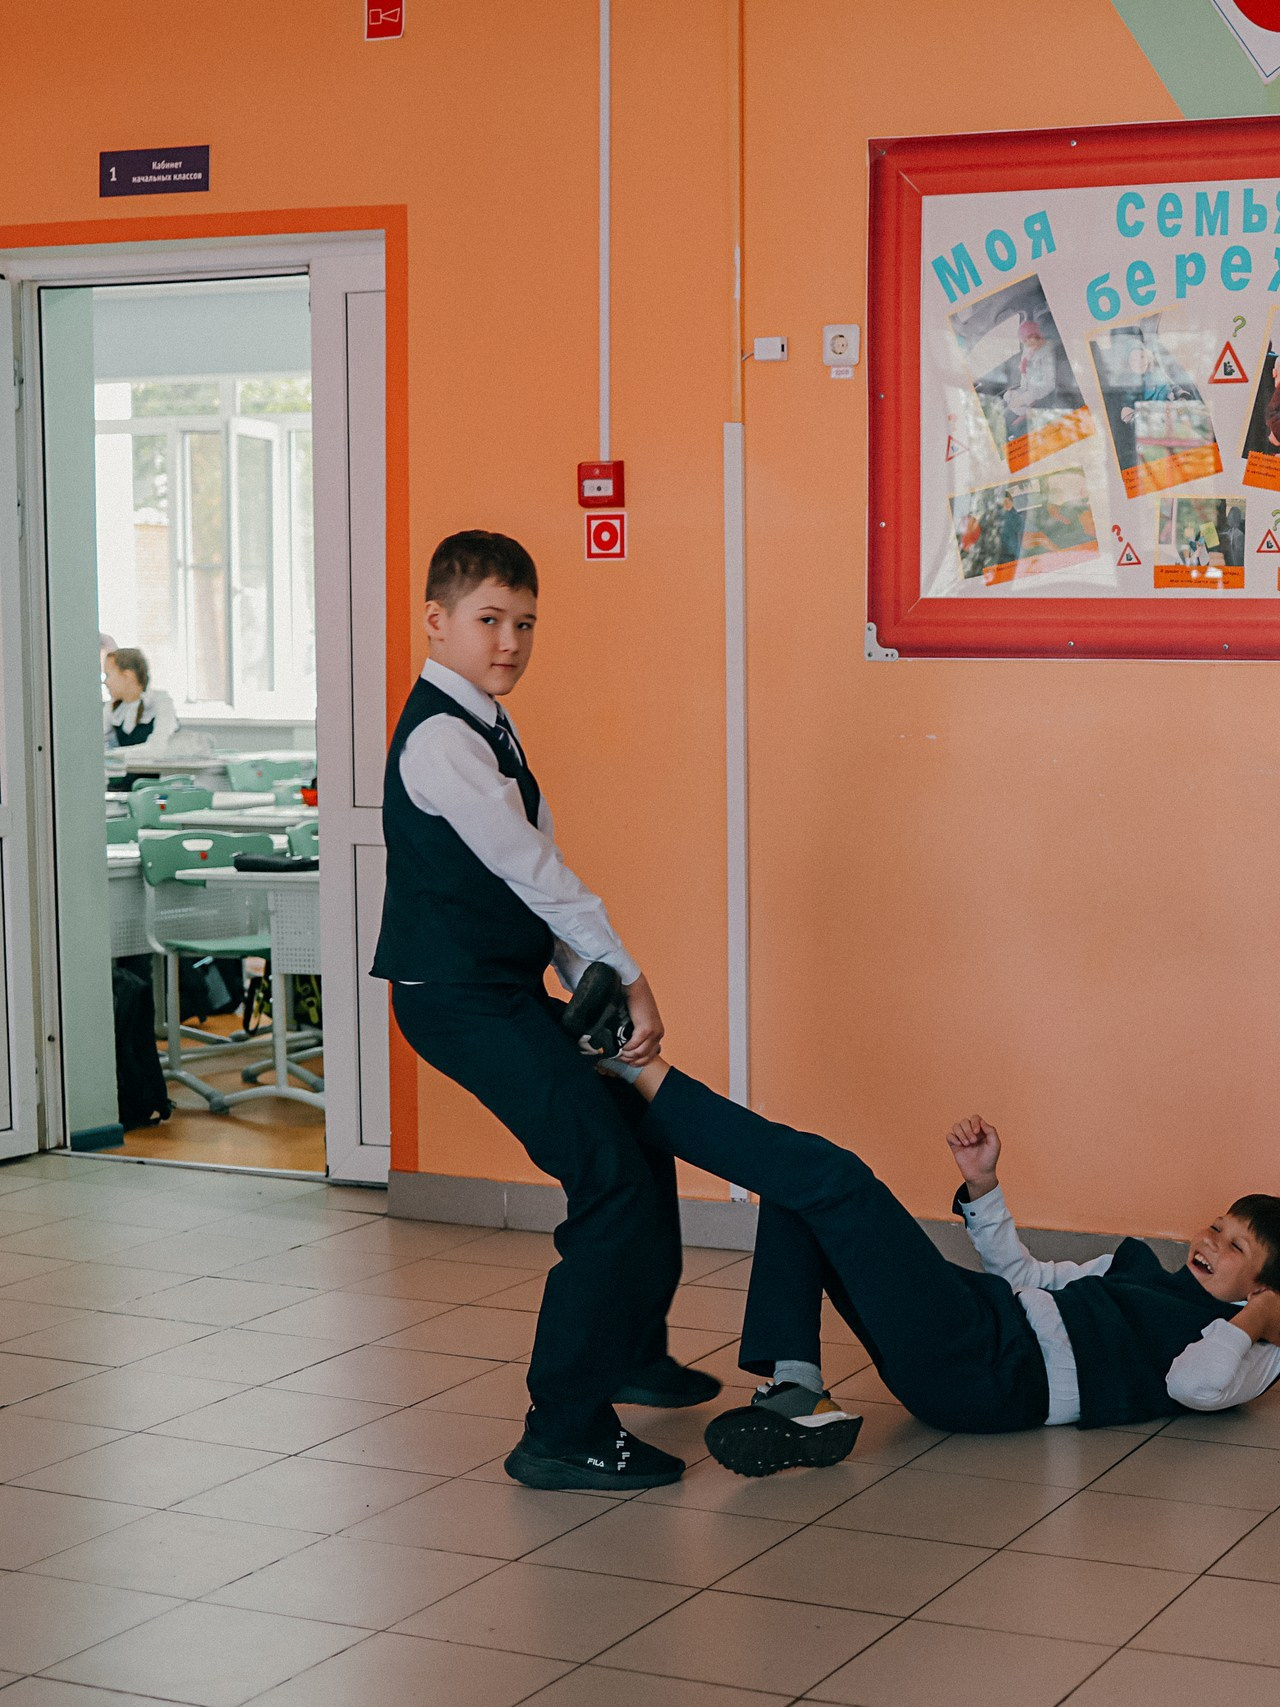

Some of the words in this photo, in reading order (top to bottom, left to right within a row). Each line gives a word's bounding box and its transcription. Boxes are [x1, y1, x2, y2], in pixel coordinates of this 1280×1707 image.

[151, 160, 183, 170] Кабинет
[109, 166, 118, 182] 1
[131, 174, 172, 183] начальных
[172, 172, 203, 181] классов
[931, 210, 1057, 304] Моя
[587, 1457, 605, 1468] FILA
